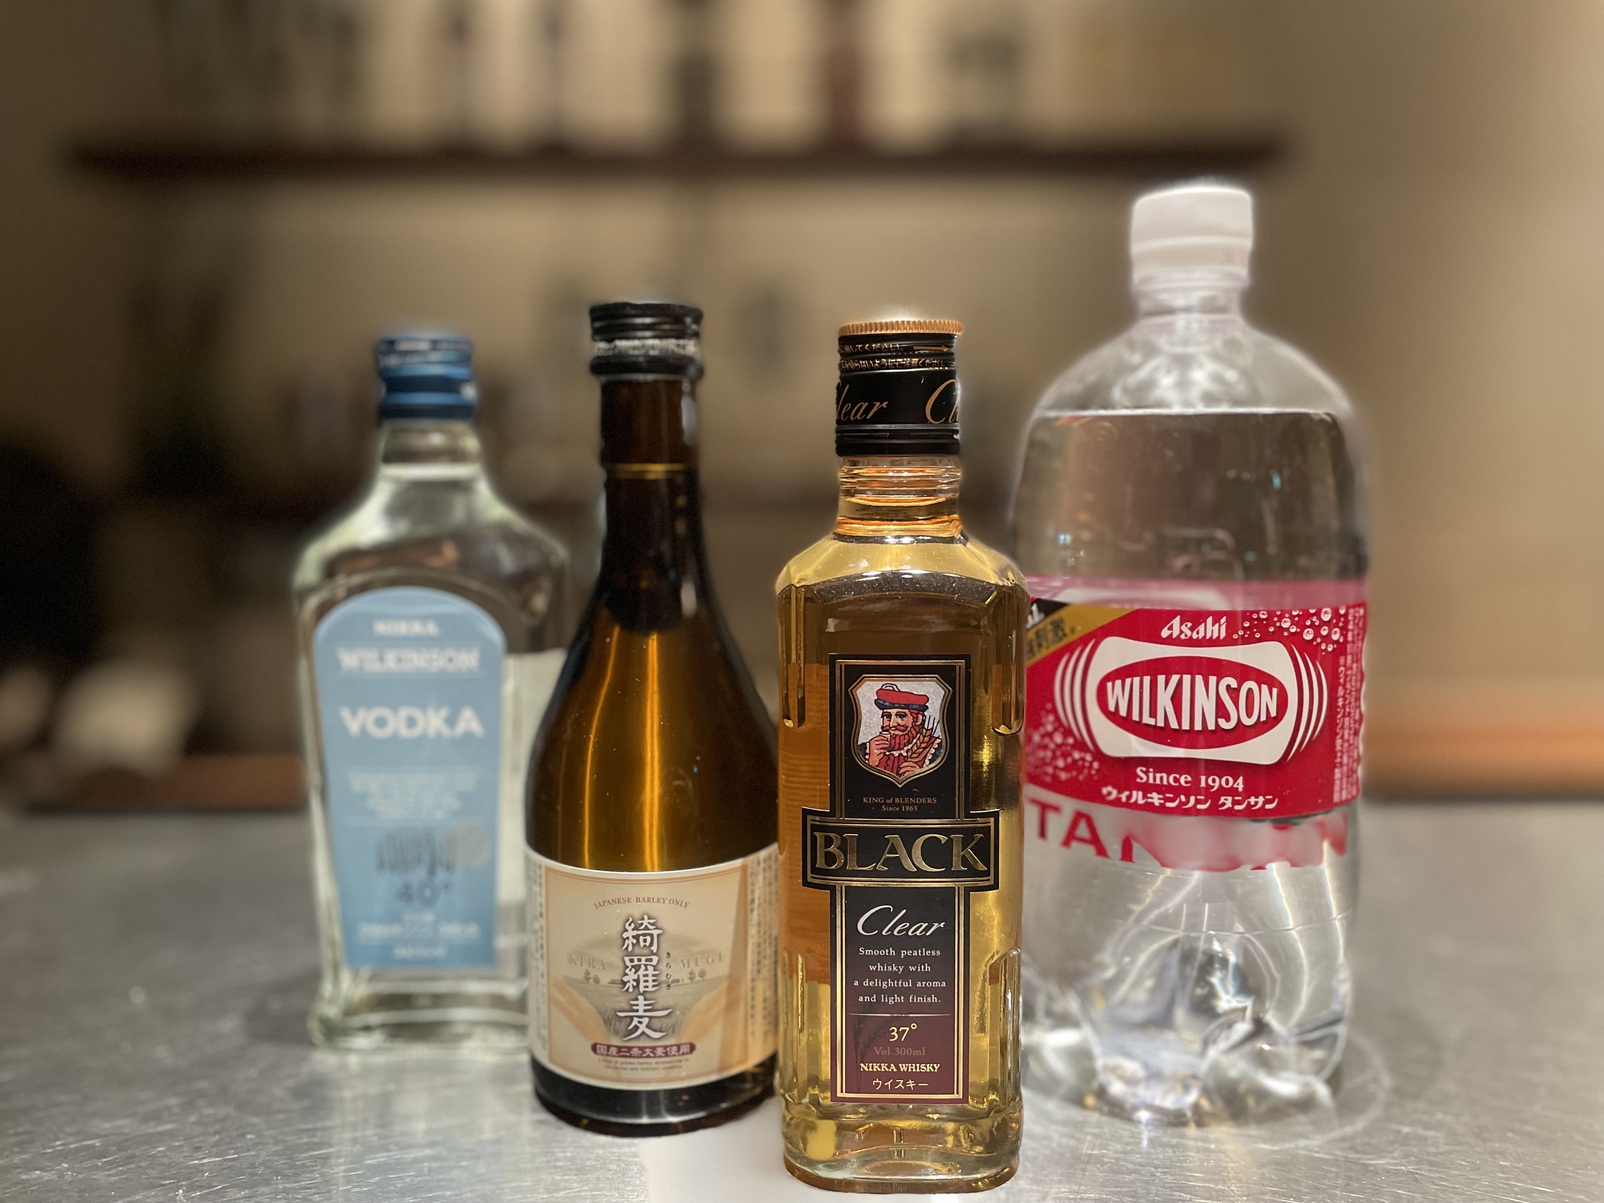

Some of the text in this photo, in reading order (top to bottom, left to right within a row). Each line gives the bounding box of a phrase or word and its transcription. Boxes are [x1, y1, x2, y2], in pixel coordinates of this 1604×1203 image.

[1160, 615, 1228, 640] Asahi
[1106, 674, 1279, 731] WILKINSON
[339, 706, 484, 739] VODKA
[1136, 767, 1246, 792] Since 1904
[863, 797, 884, 805] KING
[886, 797, 893, 805] of
[1101, 786, 1279, 810] ウィルキンソン タンサン
[813, 831, 988, 873] BLACK
[594, 896, 690, 910] JAPANESE BARLEY ONLY
[857, 905, 945, 936] Clear
[859, 947, 941, 958] Smooth peatless
[869, 963, 931, 974] whisky with
[616, 914, 673, 1041] 綺羅麦
[863, 979, 912, 990] delightful
[858, 995, 941, 1005] and light finish.
[888, 1022, 918, 1042] 37°
[874, 1046, 926, 1057] Vol.300ml
[860, 1063, 940, 1073] NIKKA WHISKY
[872, 1078, 929, 1091] ウイスキー
